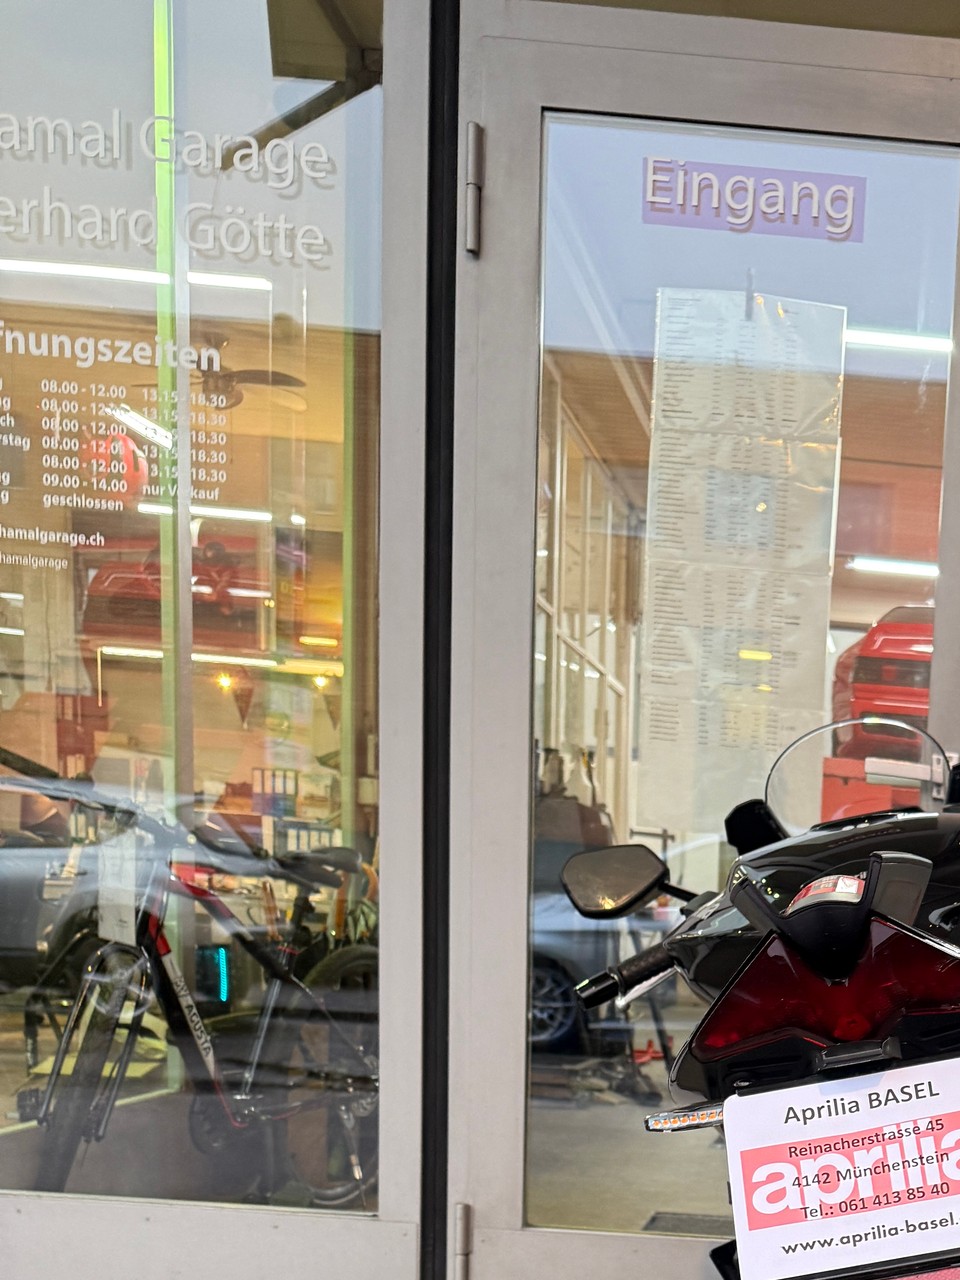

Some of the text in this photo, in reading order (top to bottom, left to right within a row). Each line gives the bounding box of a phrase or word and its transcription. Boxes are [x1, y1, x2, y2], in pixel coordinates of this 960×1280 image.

[139, 116, 329, 189] Garage
[645, 157, 856, 234] Eingang
[185, 202, 325, 261] Götte
[41, 379, 78, 395] 08.00
[90, 383, 126, 399] 12.00
[142, 388, 178, 403] 13.15
[190, 391, 227, 408] 18.30
[41, 398, 78, 414] 08.00
[190, 411, 227, 426] 18.30
[41, 416, 79, 433] 08.00
[90, 421, 127, 437] 12.00
[190, 430, 227, 446] 18.30
[42, 435, 79, 452] 08.00
[190, 448, 227, 465] 18.30
[42, 454, 79, 470] 08.00
[91, 458, 127, 475] 12.00
[143, 463, 178, 479] 3.15
[190, 466, 227, 482] 18.30
[42, 472, 80, 489] 09.00
[91, 477, 128, 493] 14.00
[142, 484, 165, 497] nur
[43, 493, 124, 511] geschlossen
[783, 1081, 940, 1126] Aprilia BASEL
[788, 1118, 945, 1158] Reinacherstrasse 45
[792, 1151, 950, 1189] 4142 Münchenstein
[800, 1181, 950, 1220] Tel.: 061 413 85 40
